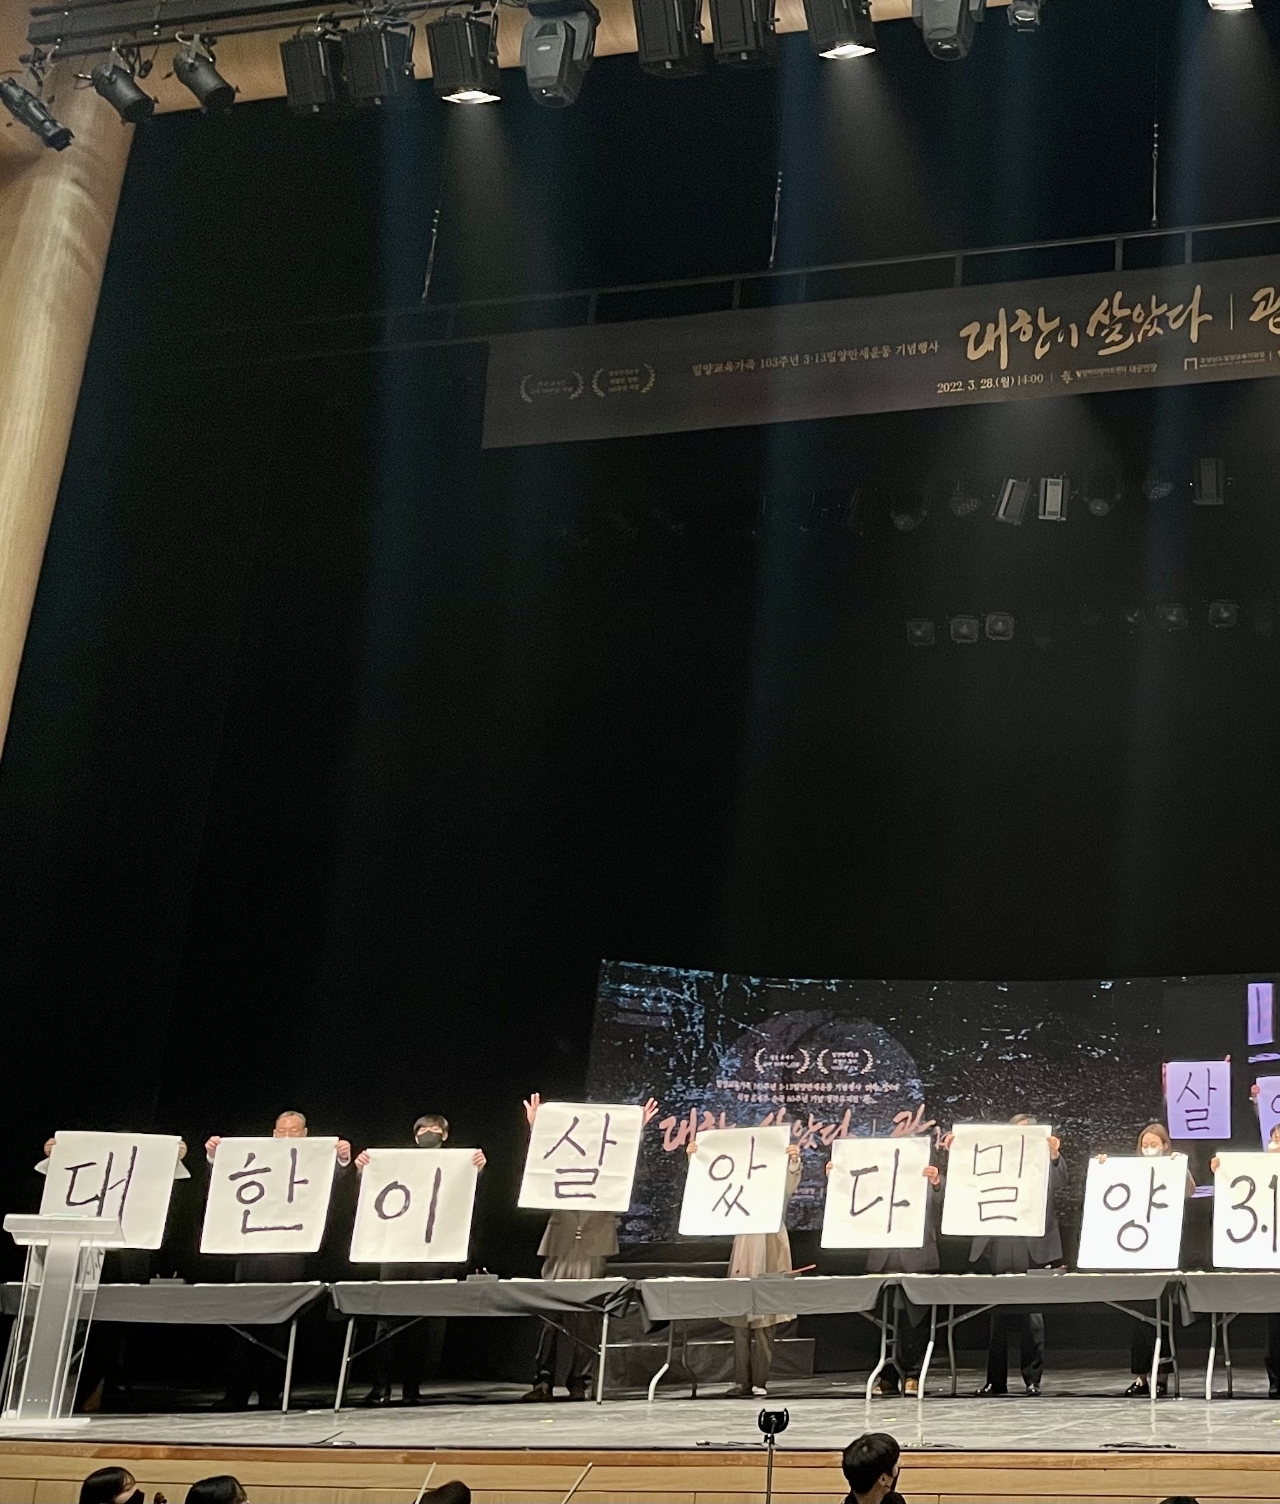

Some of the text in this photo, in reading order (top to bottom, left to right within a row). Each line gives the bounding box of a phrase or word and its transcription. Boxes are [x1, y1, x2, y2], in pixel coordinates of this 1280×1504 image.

[692, 357, 756, 377] 밀양교육가족
[760, 353, 799, 369] 103주년
[895, 340, 940, 356] 기념행사
[960, 307, 1079, 370] 대한이
[1086, 284, 1213, 356] 살았다
[937, 380, 965, 394] 2022.
[1176, 1068, 1217, 1131] 살
[64, 1145, 138, 1227] 대
[228, 1147, 309, 1235] 한
[543, 1113, 619, 1200] 살
[708, 1135, 767, 1218] 았
[850, 1147, 911, 1234] 다
[972, 1133, 1024, 1223] 밀
[374, 1166, 442, 1244] 이
[1103, 1166, 1169, 1253] 양
